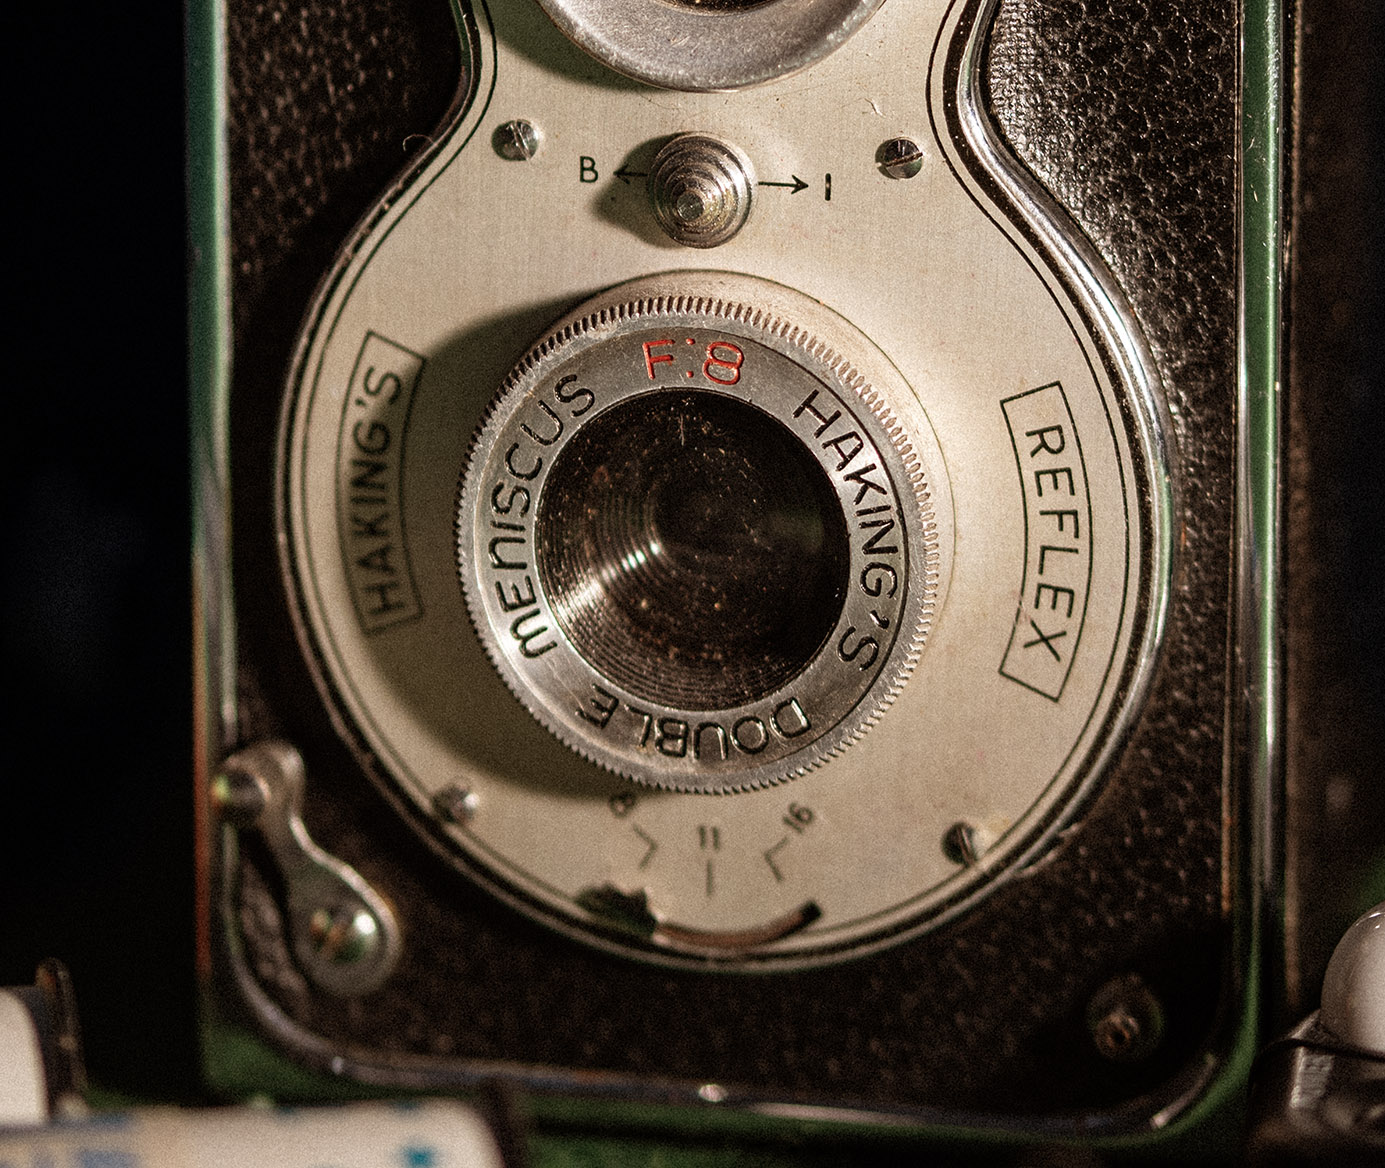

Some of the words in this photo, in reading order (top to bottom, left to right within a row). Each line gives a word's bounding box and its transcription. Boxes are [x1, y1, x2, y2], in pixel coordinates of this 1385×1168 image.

[579, 156, 599, 184] B
[642, 337, 747, 386] F:8
[350, 366, 404, 618] HAKING'S
[495, 373, 597, 660] MENISCUS
[792, 390, 904, 674] HAKING'S
[1025, 423, 1080, 660] REFLEX
[578, 684, 813, 759] DOUBLE
[783, 802, 814, 835] 16
